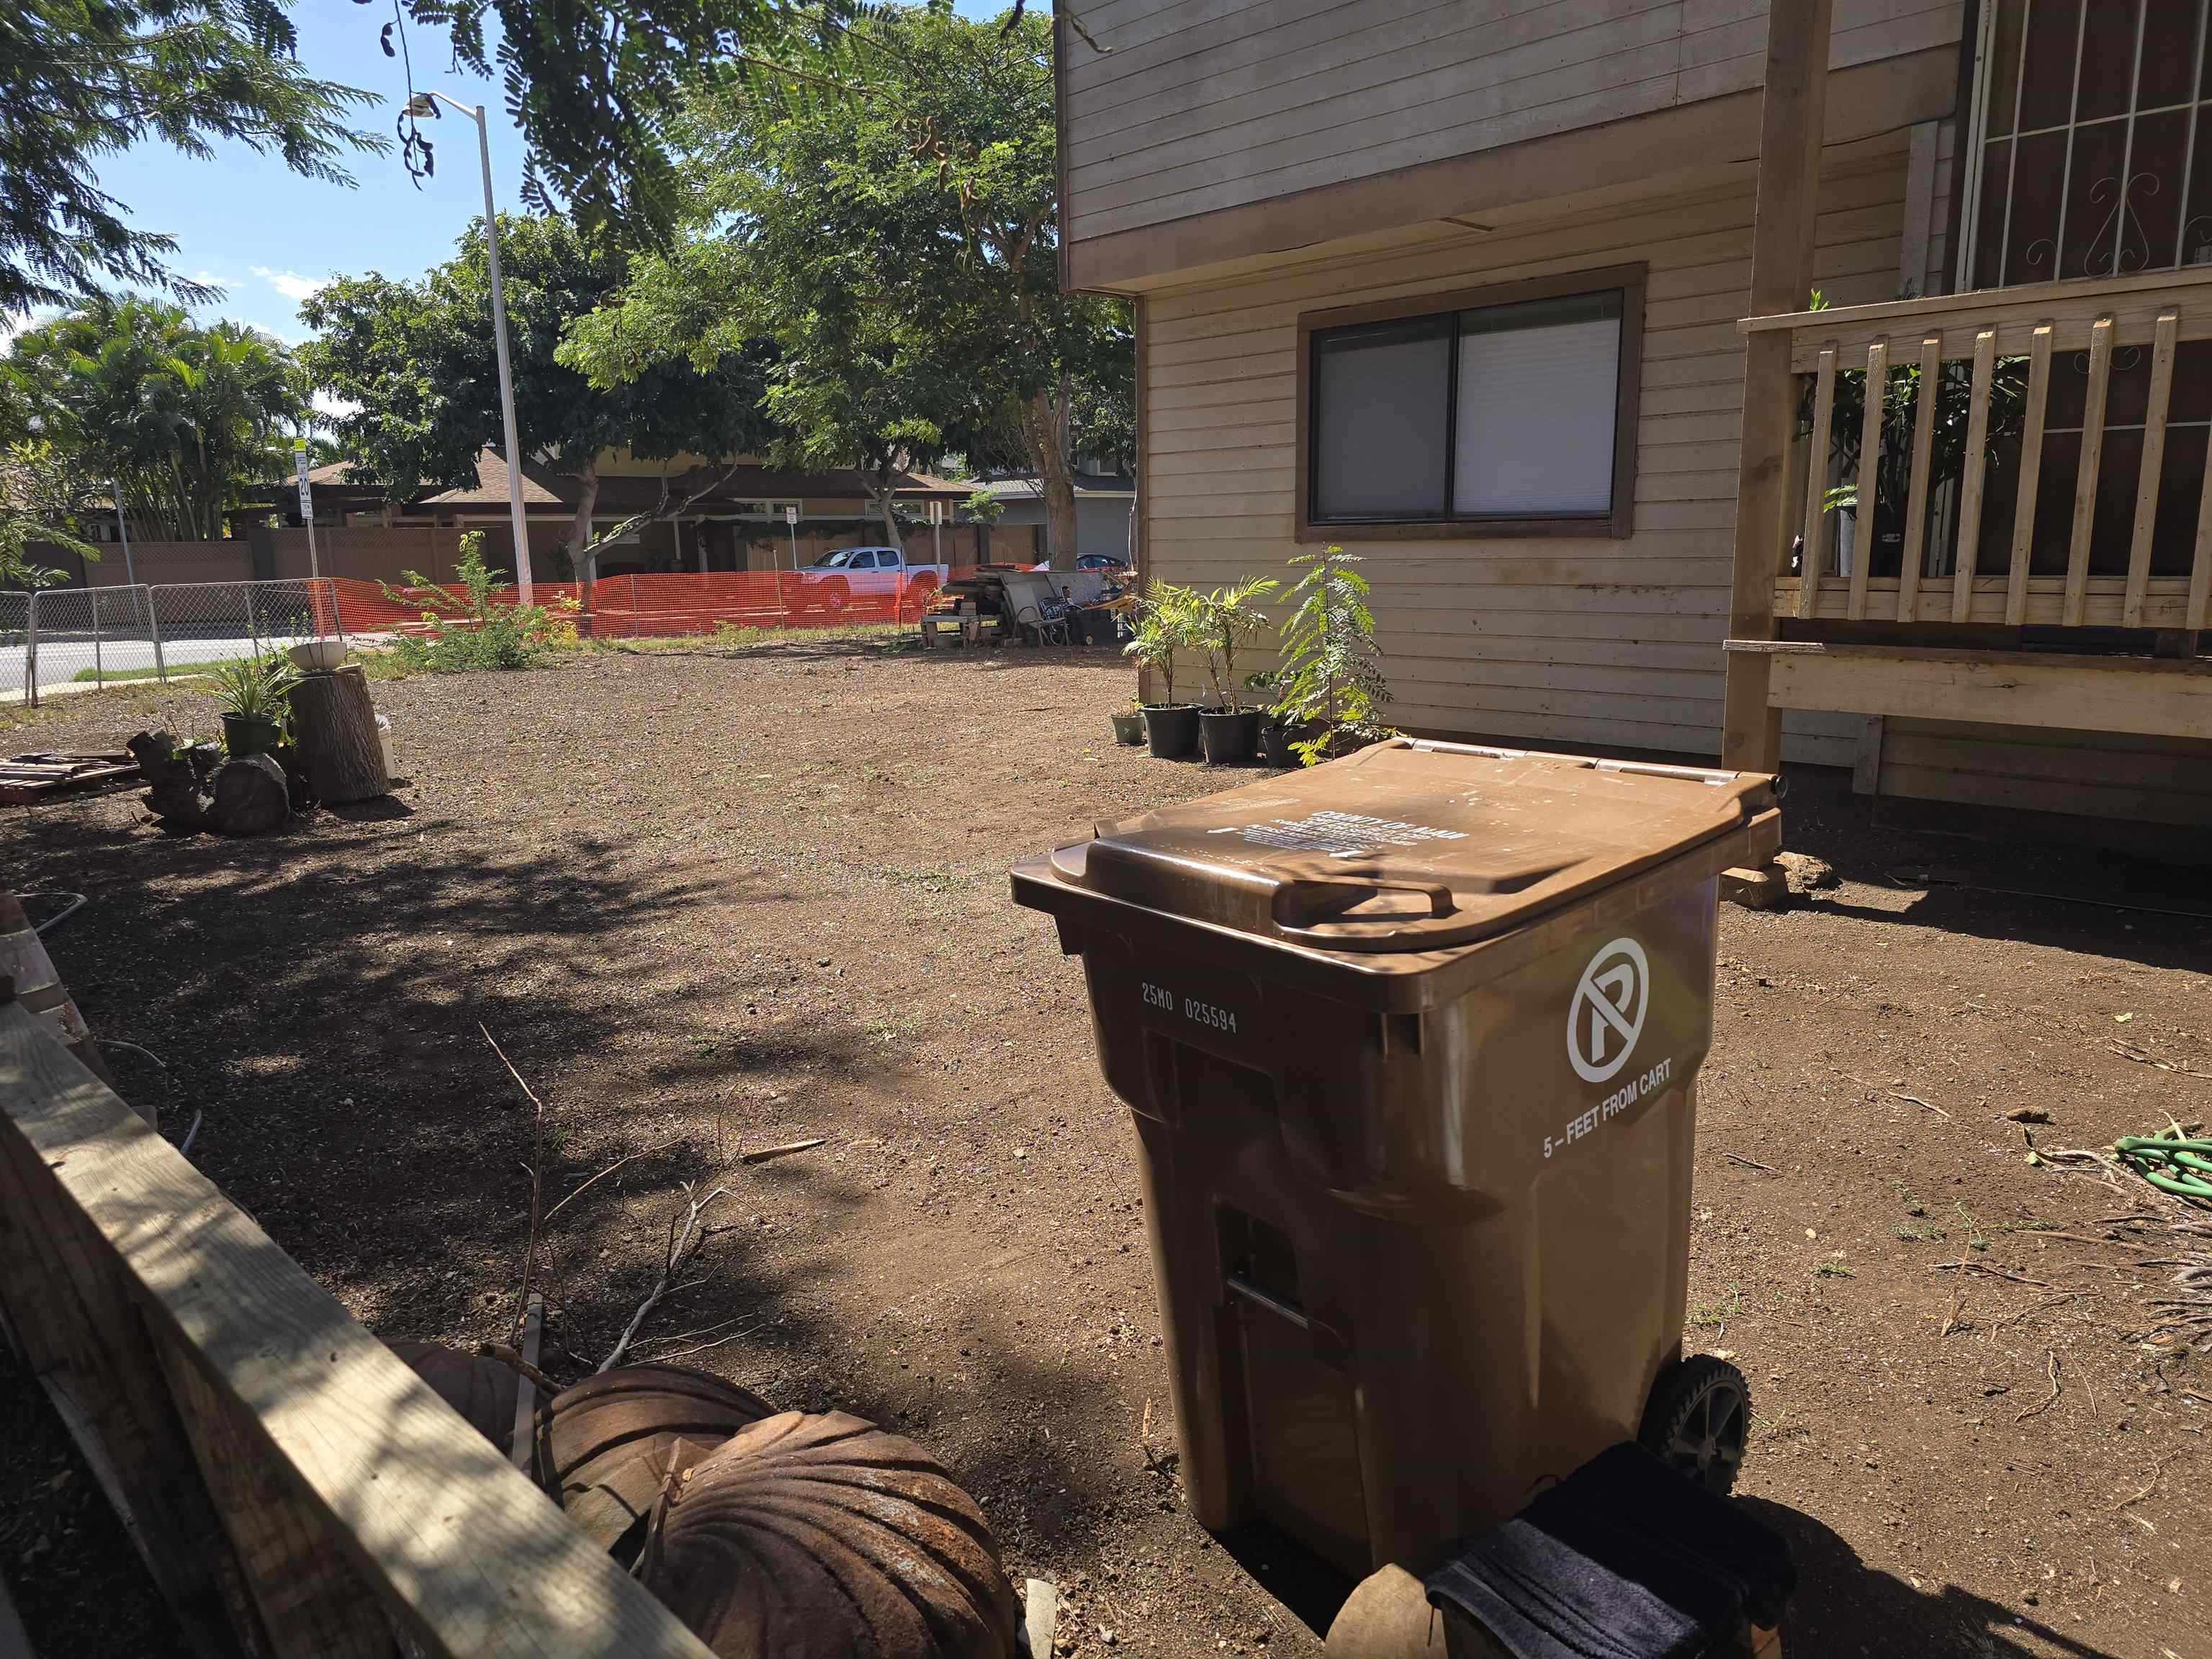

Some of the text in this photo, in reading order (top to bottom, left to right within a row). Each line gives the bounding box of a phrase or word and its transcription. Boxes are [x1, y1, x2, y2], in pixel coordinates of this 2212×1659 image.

[300, 478, 309, 495] 20
[1311, 810, 1392, 825] COUNTY
[1184, 998, 1237, 1034] 025594
[1566, 1105, 1600, 1146] FEET
[1602, 1079, 1638, 1122] FROM
[1640, 1057, 1672, 1096] CART
